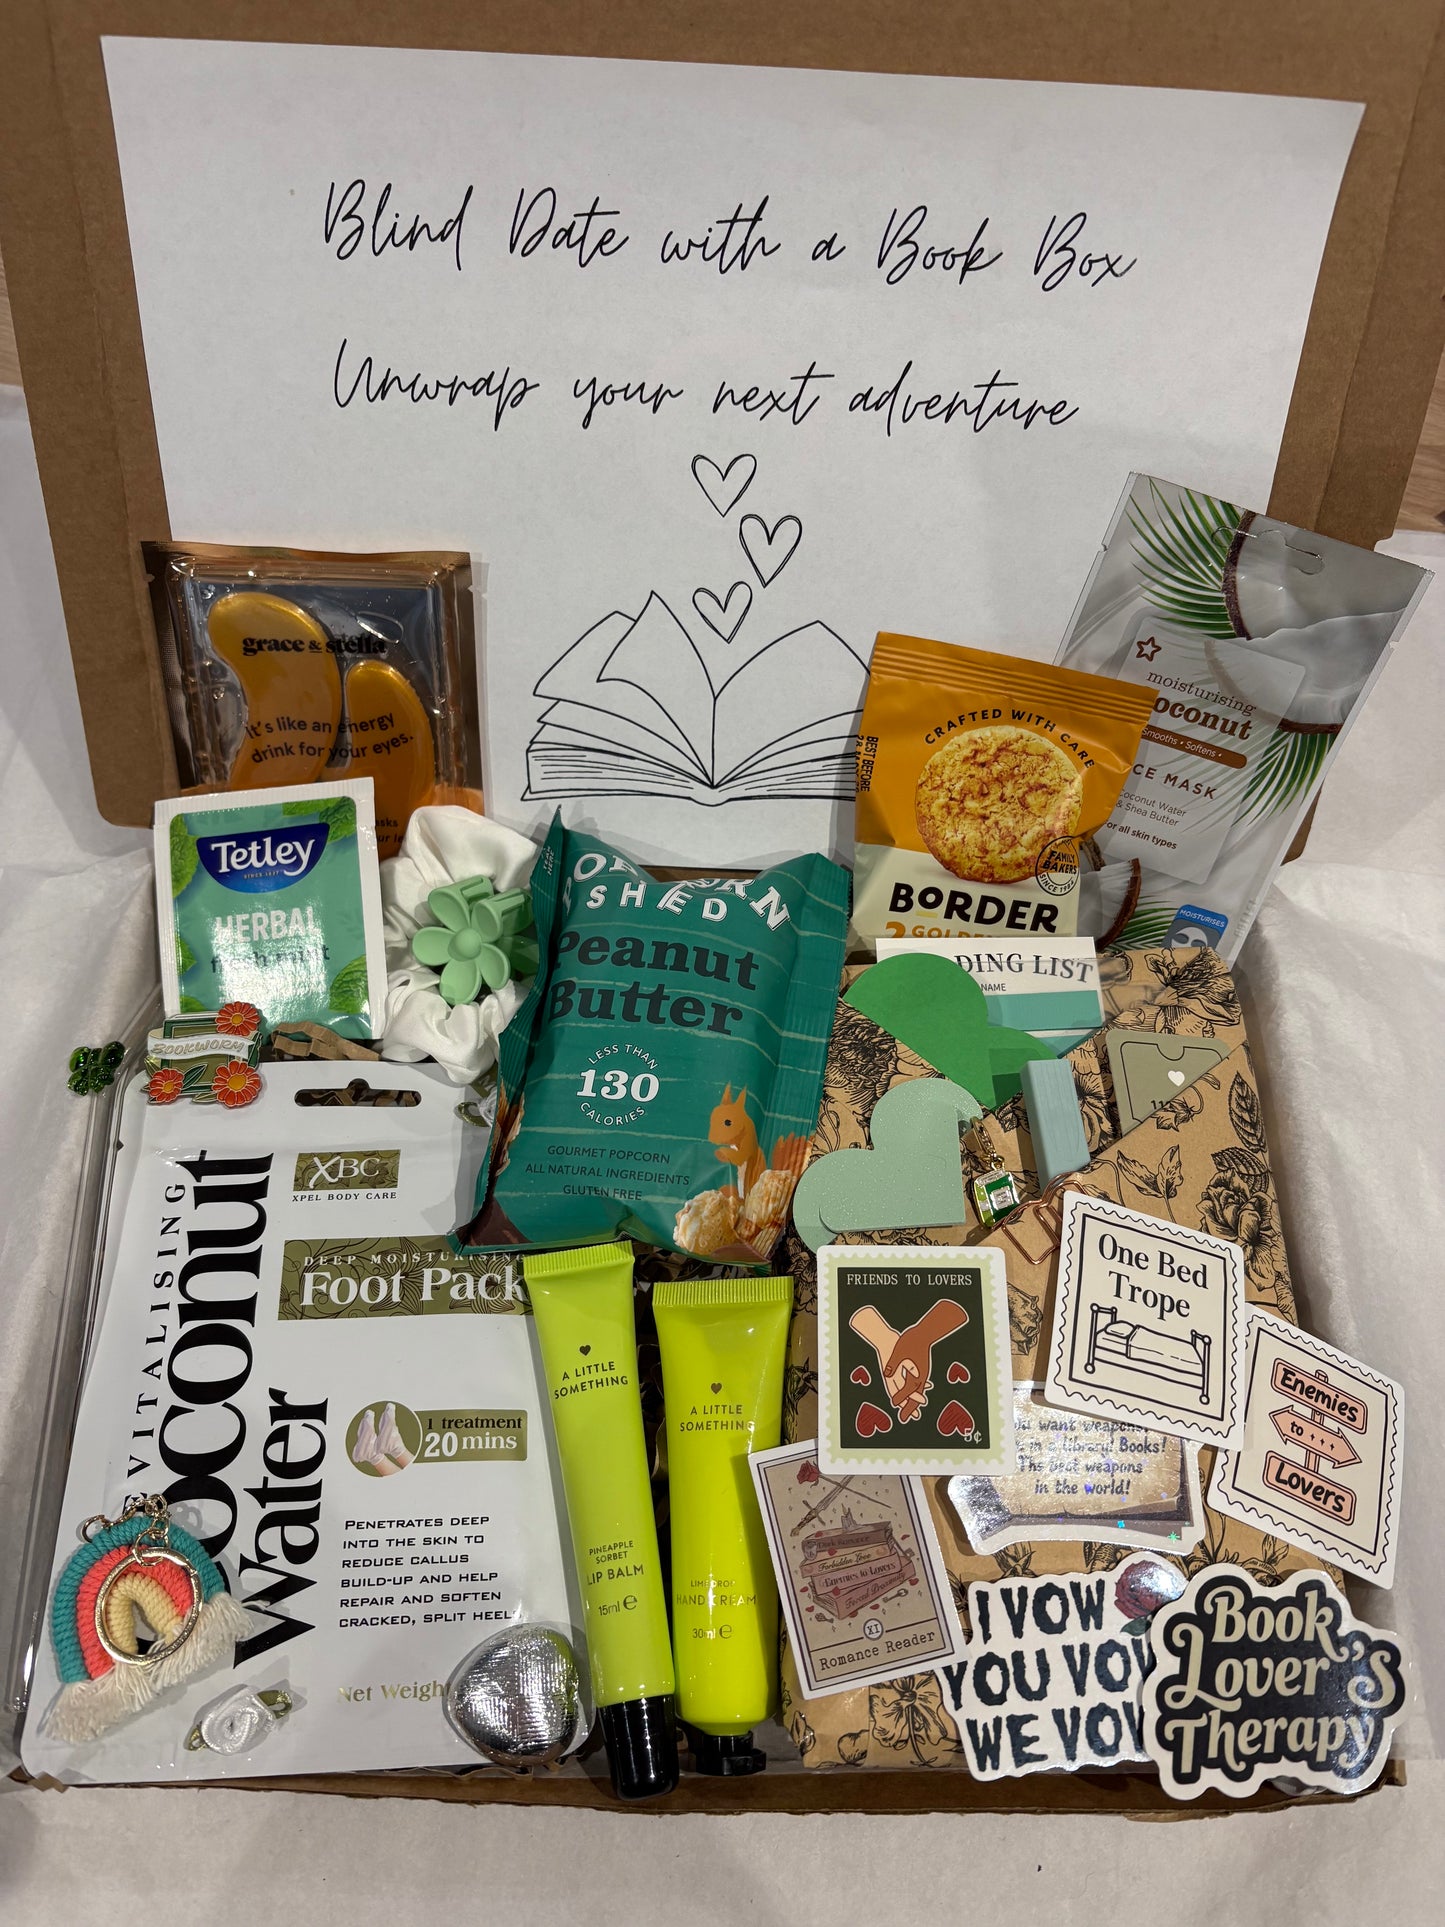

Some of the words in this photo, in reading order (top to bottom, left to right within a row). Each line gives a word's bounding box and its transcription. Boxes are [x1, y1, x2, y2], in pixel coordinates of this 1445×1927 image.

[324, 179, 473, 271] Blind
[510, 188, 630, 268] Date
[660, 196, 782, 275] with
[811, 232, 847, 261] a
[877, 206, 1004, 286] Book
[1034, 212, 1138, 292] Box
[334, 338, 540, 431] Unwrap
[572, 384, 684, 430] your
[714, 363, 834, 424] next
[848, 362, 1080, 436] adventure
[242, 637, 305, 656] grace
[309, 640, 322, 652] &
[325, 633, 386, 654] stella
[1147, 671, 1257, 717] moisturising
[246, 721, 274, 739] It's
[276, 717, 307, 731] like
[312, 721, 331, 733] an
[338, 713, 395, 733] energy
[1153, 697, 1252, 740] oconut
[252, 742, 295, 763] drink
[299, 742, 324, 756] for
[329, 746, 368, 761] your
[372, 734, 414, 754] eyes.
[864, 736, 879, 758] BEST
[925, 708, 1002, 745] CRAFTED
[1011, 709, 1057, 733] WITH
[1060, 733, 1095, 769] CARE
[1142, 727, 1178, 745] Smooths
[1185, 741, 1216, 757] Softens
[860, 759, 874, 792] BEFORE
[1133, 764, 1157, 780] CE
[1164, 773, 1217, 800] MASK
[1116, 800, 1123, 808] &
[1126, 803, 1148, 817] Shea
[1149, 811, 1180, 827] Butter
[1158, 801, 1187, 817] Water
[1106, 821, 1117, 831] or
[1119, 823, 1130, 835] all
[1131, 829, 1150, 841] skin
[1152, 836, 1178, 850] types
[211, 837, 315, 876] Tetley
[1042, 860, 1078, 875] BAKERS
[1047, 850, 1075, 864] FAMILY
[1040, 874, 1058, 892] SINCE
[586, 881, 729, 922] SHED
[888, 881, 1060, 934] BORDER
[216, 906, 321, 944] HERBAL
[1180, 909, 1225, 928] MOISTURISES
[556, 930, 760, 991] Peanut
[1032, 955, 1094, 983] LIST
[980, 983, 1007, 992] NAME
[548, 977, 743, 1036] Butter
[151, 1039, 246, 1055] BOOKWORM
[588, 1044, 619, 1065] LESS
[625, 1044, 658, 1070] THAN
[576, 1068, 660, 1103] 130
[580, 1102, 645, 1126] CALORIES
[548, 1146, 606, 1158] GOURMET
[609, 1150, 671, 1164] POPCORN
[309, 1156, 380, 1189] XBC
[525, 1164, 545, 1174] ALL
[548, 1165, 602, 1177] NATURAL
[606, 1168, 690, 1185] INGREDIENTS
[327, 1193, 360, 1201] BODY
[366, 1192, 397, 1200] CARE
[563, 1185, 609, 1197] GLUTEN
[613, 1189, 642, 1200] FREE
[304, 1255, 357, 1267] DEEP
[1098, 1233, 1149, 1270] One
[1158, 1251, 1209, 1290] Bed
[300, 1270, 405, 1306] Foot
[846, 1273, 898, 1285] FRIENDS
[905, 1274, 921, 1286] TO
[928, 1274, 972, 1286] LOVERS
[1108, 1271, 1191, 1321] Trope
[150, 1150, 273, 1597] oconut
[562, 1371, 570, 1381] A
[575, 1361, 616, 1378] LITTLE
[554, 1375, 629, 1400] SOMETHING
[1280, 1367, 1359, 1424] Enemies
[690, 1406, 698, 1415] A
[703, 1404, 743, 1415] LITTLE
[427, 1418, 433, 1429] 1
[442, 1416, 522, 1429] treatment
[1290, 1420, 1303, 1437] to
[424, 1431, 458, 1457] 20
[462, 1431, 517, 1450] mins
[963, 1428, 983, 1444] 5¢
[1119, 1436, 1167, 1453] Books!
[1085, 1463, 1143, 1478] weapons
[1034, 1479, 1049, 1494] in
[1056, 1479, 1078, 1494] the
[1084, 1479, 1131, 1495] world!
[1274, 1461, 1346, 1513] Lovers
[233, 1387, 328, 1669] Water
[345, 1518, 443, 1530] PENETRATES
[450, 1517, 490, 1526] DEEP
[343, 1539, 379, 1549] INTO
[386, 1538, 416, 1547] THE
[422, 1536, 458, 1546] SKIN
[464, 1535, 484, 1544] TO
[589, 1539, 635, 1556] PINEAPPLE
[342, 1557, 404, 1568] REDUCE
[410, 1555, 469, 1565] CALLUS
[596, 1551, 629, 1565] SORBET
[341, 1576, 413, 1588] BUILD-UP
[420, 1574, 452, 1584] AND
[459, 1573, 498, 1582] HELP
[587, 1571, 603, 1586] LIP
[607, 1564, 645, 1580] BALM
[340, 1597, 394, 1608] REPAIR
[401, 1595, 434, 1605] AND
[440, 1592, 501, 1602] SOFTEN
[598, 1603, 621, 1616] 15ml
[676, 1594, 705, 1606] HAND
[975, 1590, 992, 1644] I
[1000, 1579, 1105, 1639] VOW
[339, 1615, 416, 1628] CRACKED,
[423, 1613, 466, 1623] SPLIT
[867, 1624, 880, 1634] XI
[1204, 1585, 1349, 1662] Book
[692, 1628, 716, 1640] 30ml
[820, 1646, 880, 1670] Romance
[885, 1630, 936, 1655] Reader
[942, 1649, 1051, 1711] YOU
[338, 1686, 372, 1703] Net
[966, 1714, 1048, 1772] WE
[1164, 1710, 1374, 1773] Therapy
